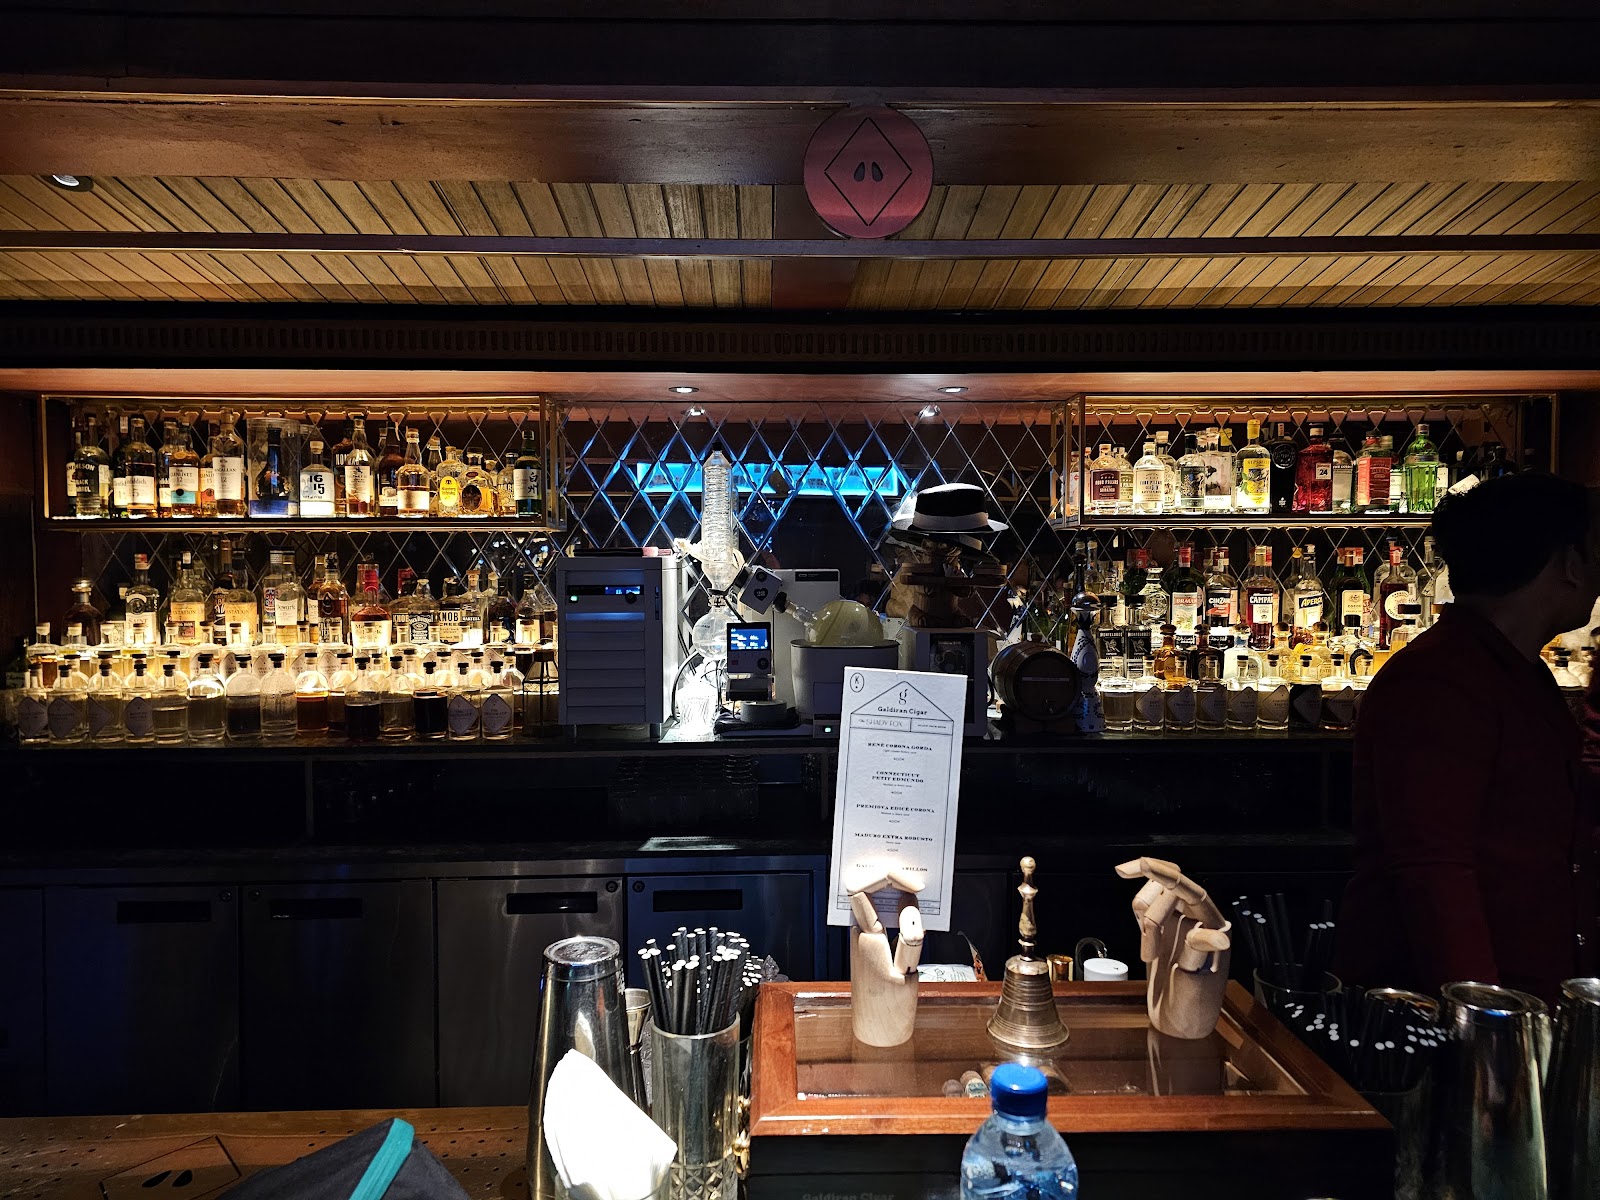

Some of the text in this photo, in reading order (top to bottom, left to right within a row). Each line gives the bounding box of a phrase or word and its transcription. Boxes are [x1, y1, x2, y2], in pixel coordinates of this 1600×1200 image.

[309, 474, 324, 483] 16
[313, 483, 325, 495] 15
[1249, 596, 1273, 604] CAMPA
[435, 611, 459, 622] KNOB
[877, 706, 928, 717] Galdiran Cigar
[889, 719, 903, 727] FOX
[876, 770, 920, 778] CONNECTICUT
